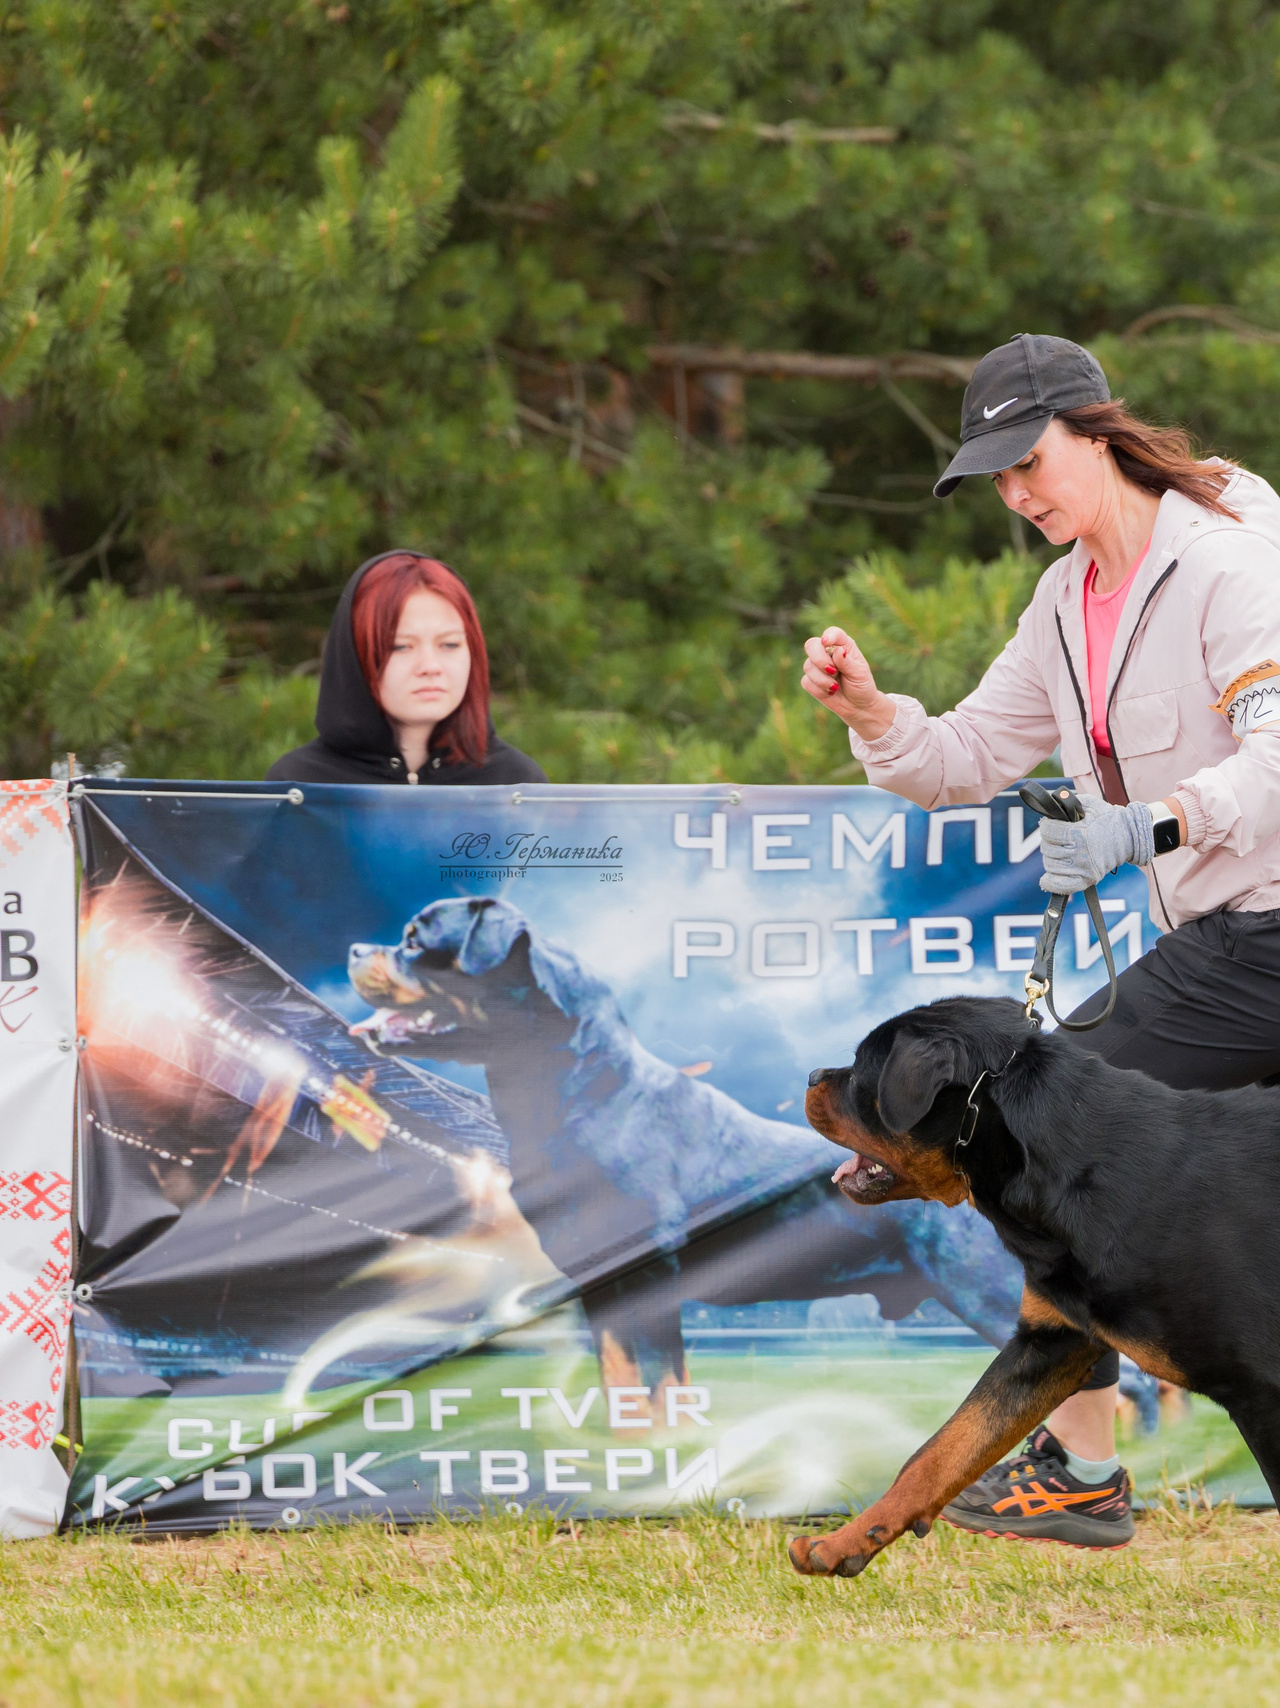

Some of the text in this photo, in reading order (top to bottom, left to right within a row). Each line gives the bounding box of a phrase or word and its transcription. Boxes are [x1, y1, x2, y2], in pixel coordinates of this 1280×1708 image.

[363, 1388, 472, 1432] OF
[501, 1386, 714, 1429] TVER
[420, 1447, 721, 1496] ТВЕРИ
